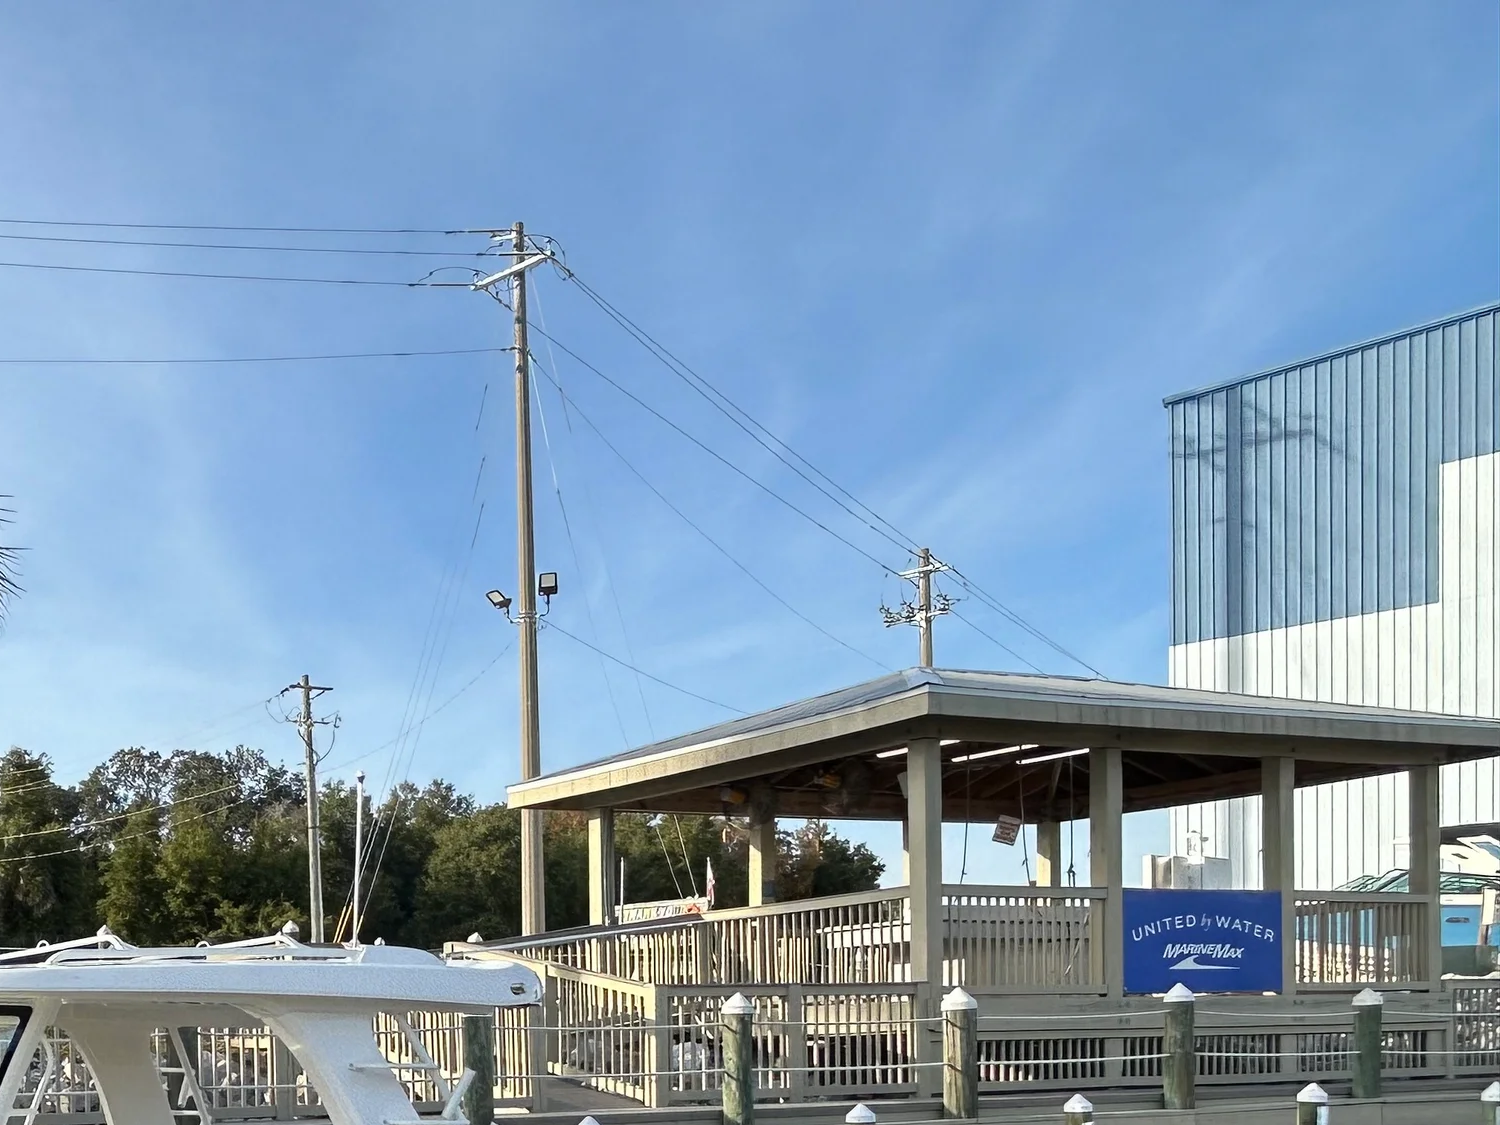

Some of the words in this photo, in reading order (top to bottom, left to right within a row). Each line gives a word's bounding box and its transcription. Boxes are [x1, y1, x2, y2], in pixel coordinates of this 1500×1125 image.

[1132, 914, 1197, 942] UNITED
[1201, 913, 1213, 931] by
[1215, 915, 1275, 943] WATER
